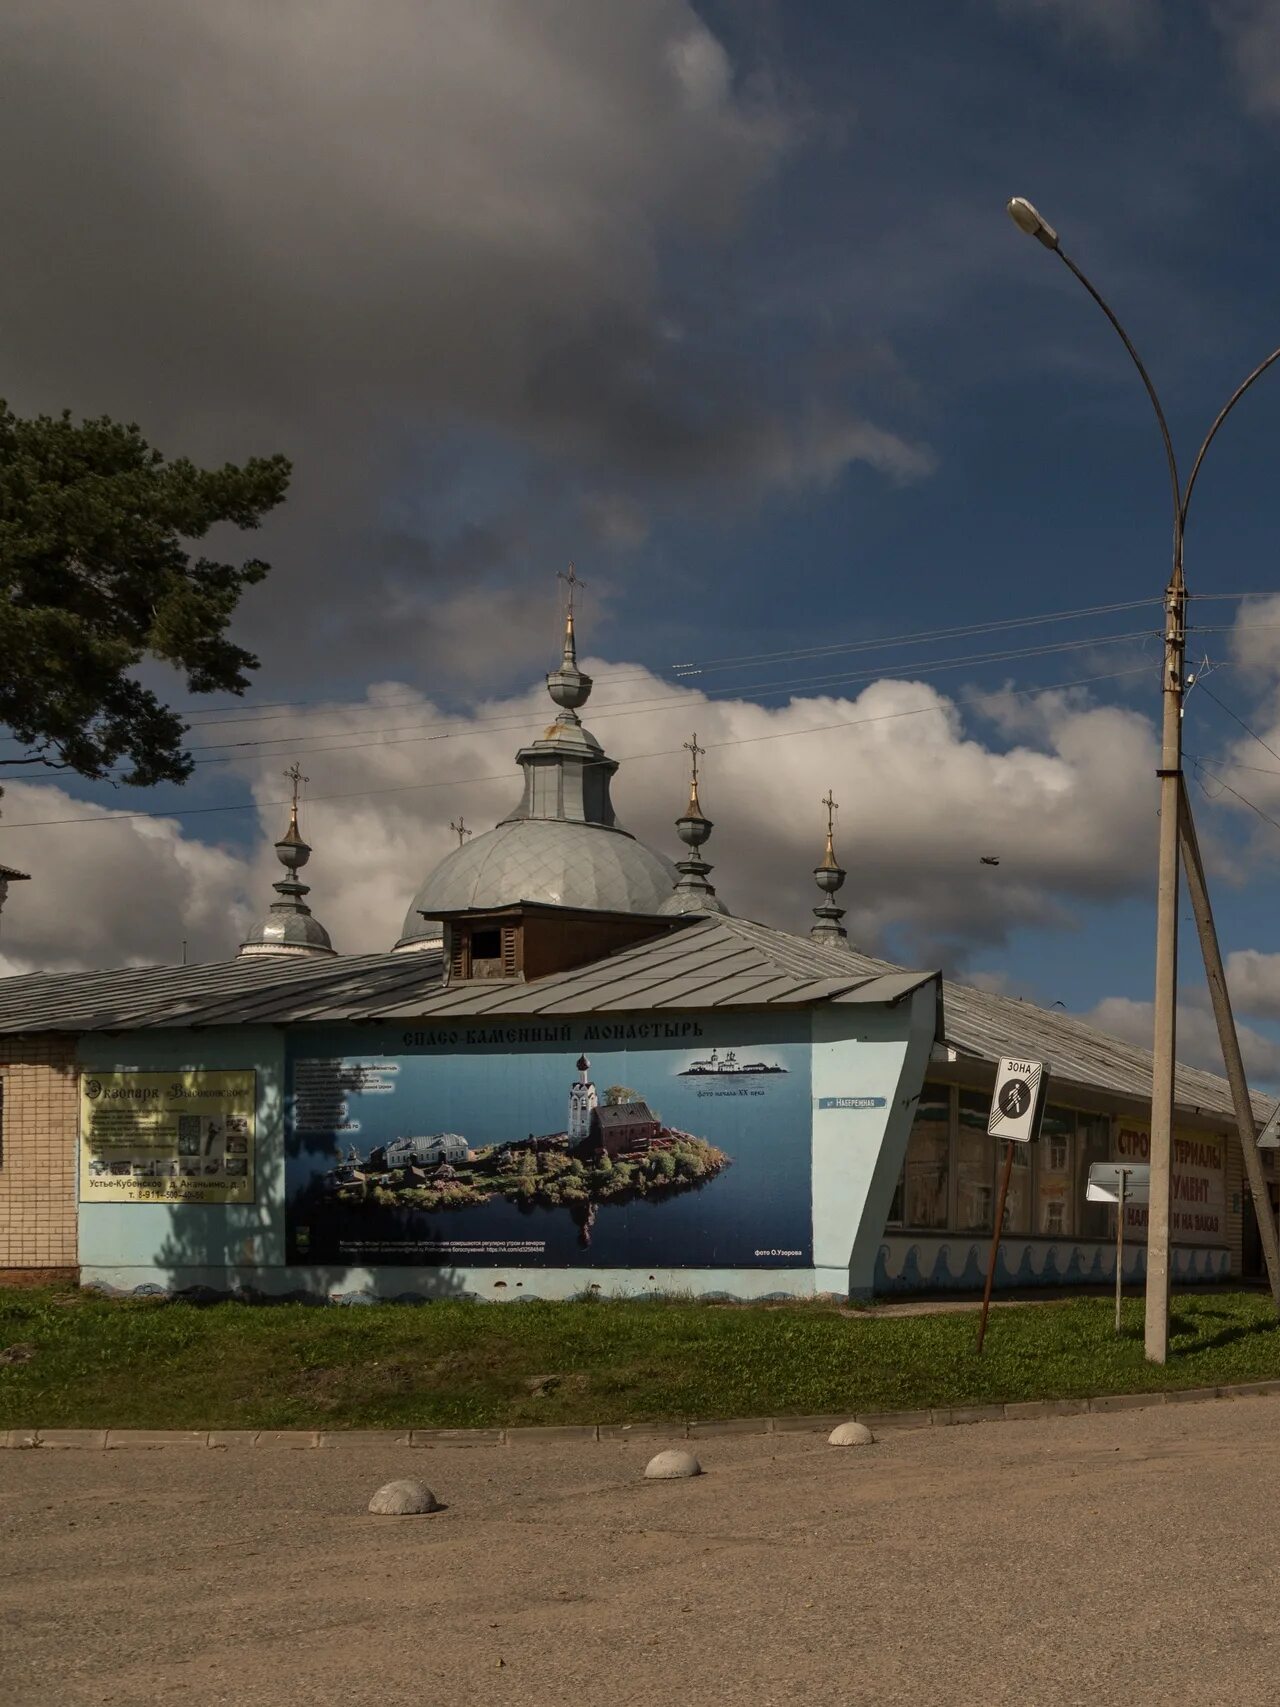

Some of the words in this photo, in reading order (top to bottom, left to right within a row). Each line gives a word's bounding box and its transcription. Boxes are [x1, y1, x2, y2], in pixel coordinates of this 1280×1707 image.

[402, 1024, 572, 1046] СПАСО-КАМЕННЫЙ
[583, 1021, 704, 1040] МОНАСТЫРЬ
[1007, 1061, 1031, 1074] ЗОНА
[85, 1079, 160, 1103] Экзопарк
[89, 1179, 162, 1190] Устье-Кубенское
[1194, 1214, 1219, 1233] ЗАКАЗ
[754, 1249, 771, 1257] фото
[771, 1248, 803, 1257] О.Узорова
